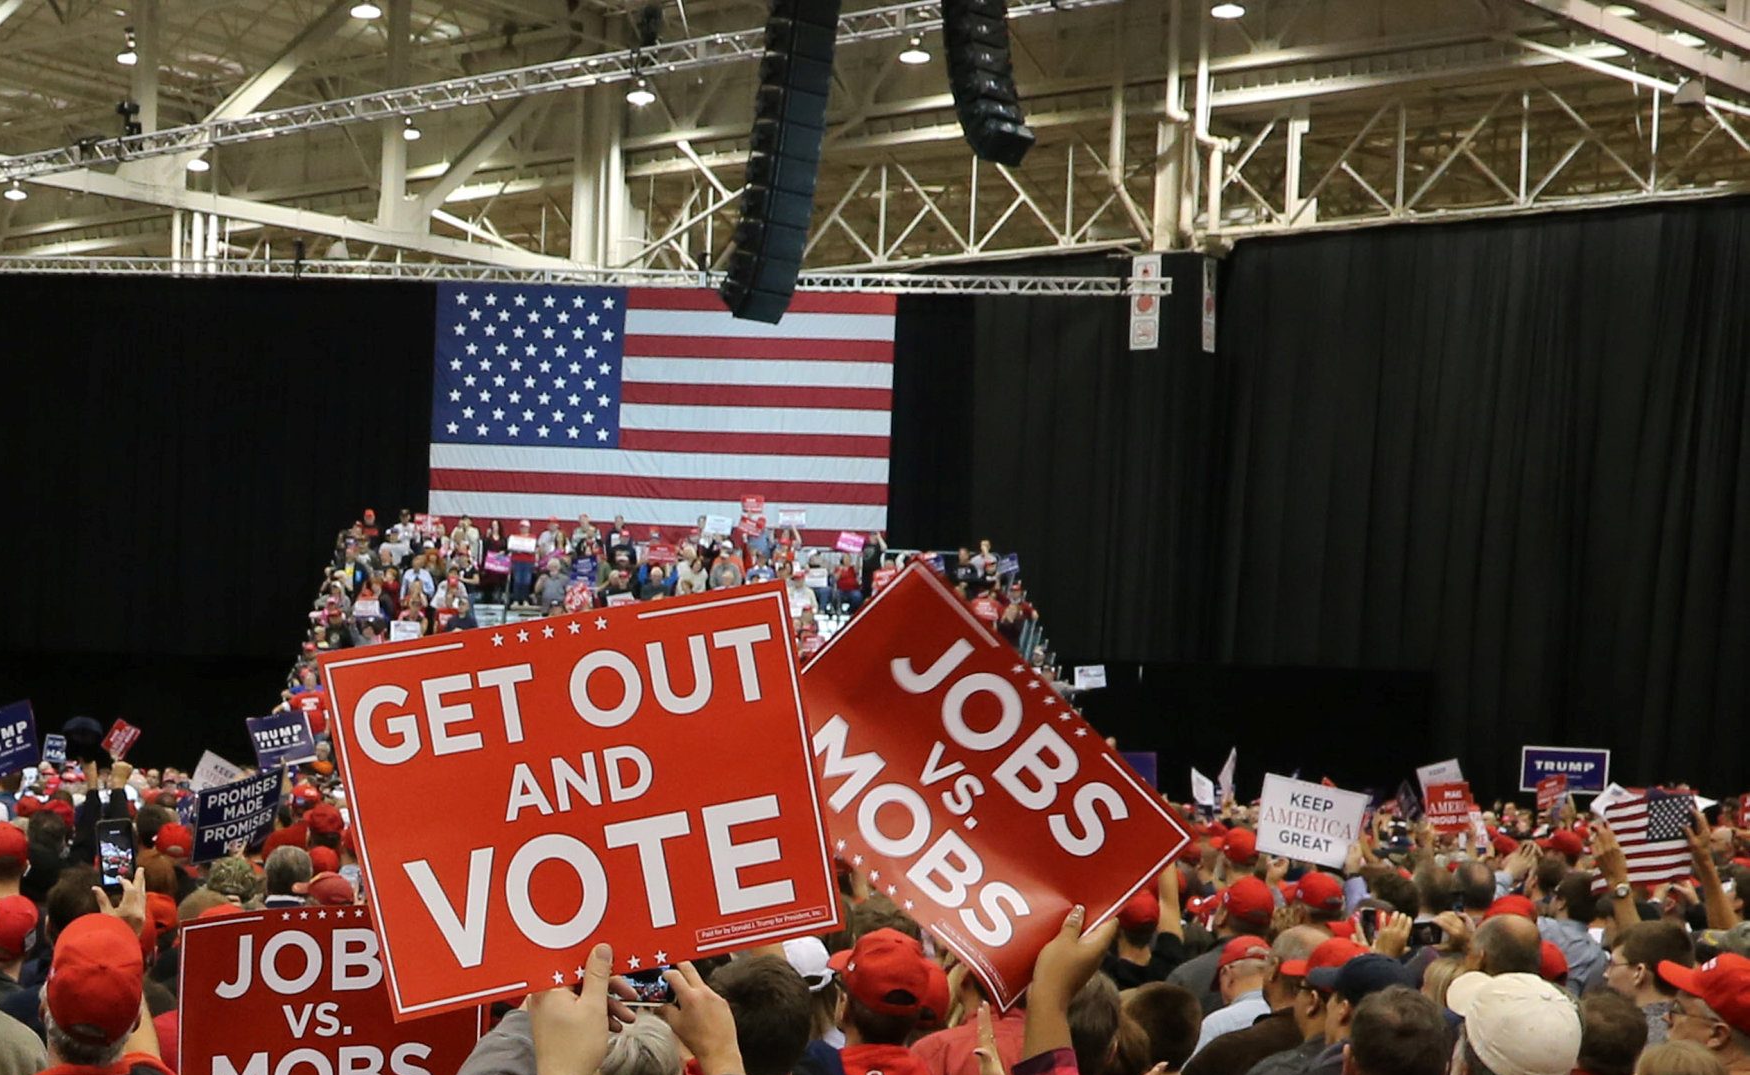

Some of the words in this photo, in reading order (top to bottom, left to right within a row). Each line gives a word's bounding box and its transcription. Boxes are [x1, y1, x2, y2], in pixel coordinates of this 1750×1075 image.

[353, 664, 534, 766] GET
[568, 624, 773, 728] OUT
[254, 723, 303, 743] TRUMP
[890, 638, 1129, 857] JOBS
[505, 745, 653, 822] AND
[1533, 760, 1595, 773] TRUMP
[207, 774, 278, 809] PROMISES
[223, 796, 264, 821] MADE
[1290, 792, 1334, 814] KEEP
[204, 808, 272, 843] PROMISES
[812, 714, 1030, 948] MOBS
[1264, 805, 1353, 840] AMERICA
[1278, 829, 1333, 853] GREAT
[402, 795, 796, 969] VOTE
[214, 928, 383, 999] JOB
[282, 1003, 353, 1039] VS.
